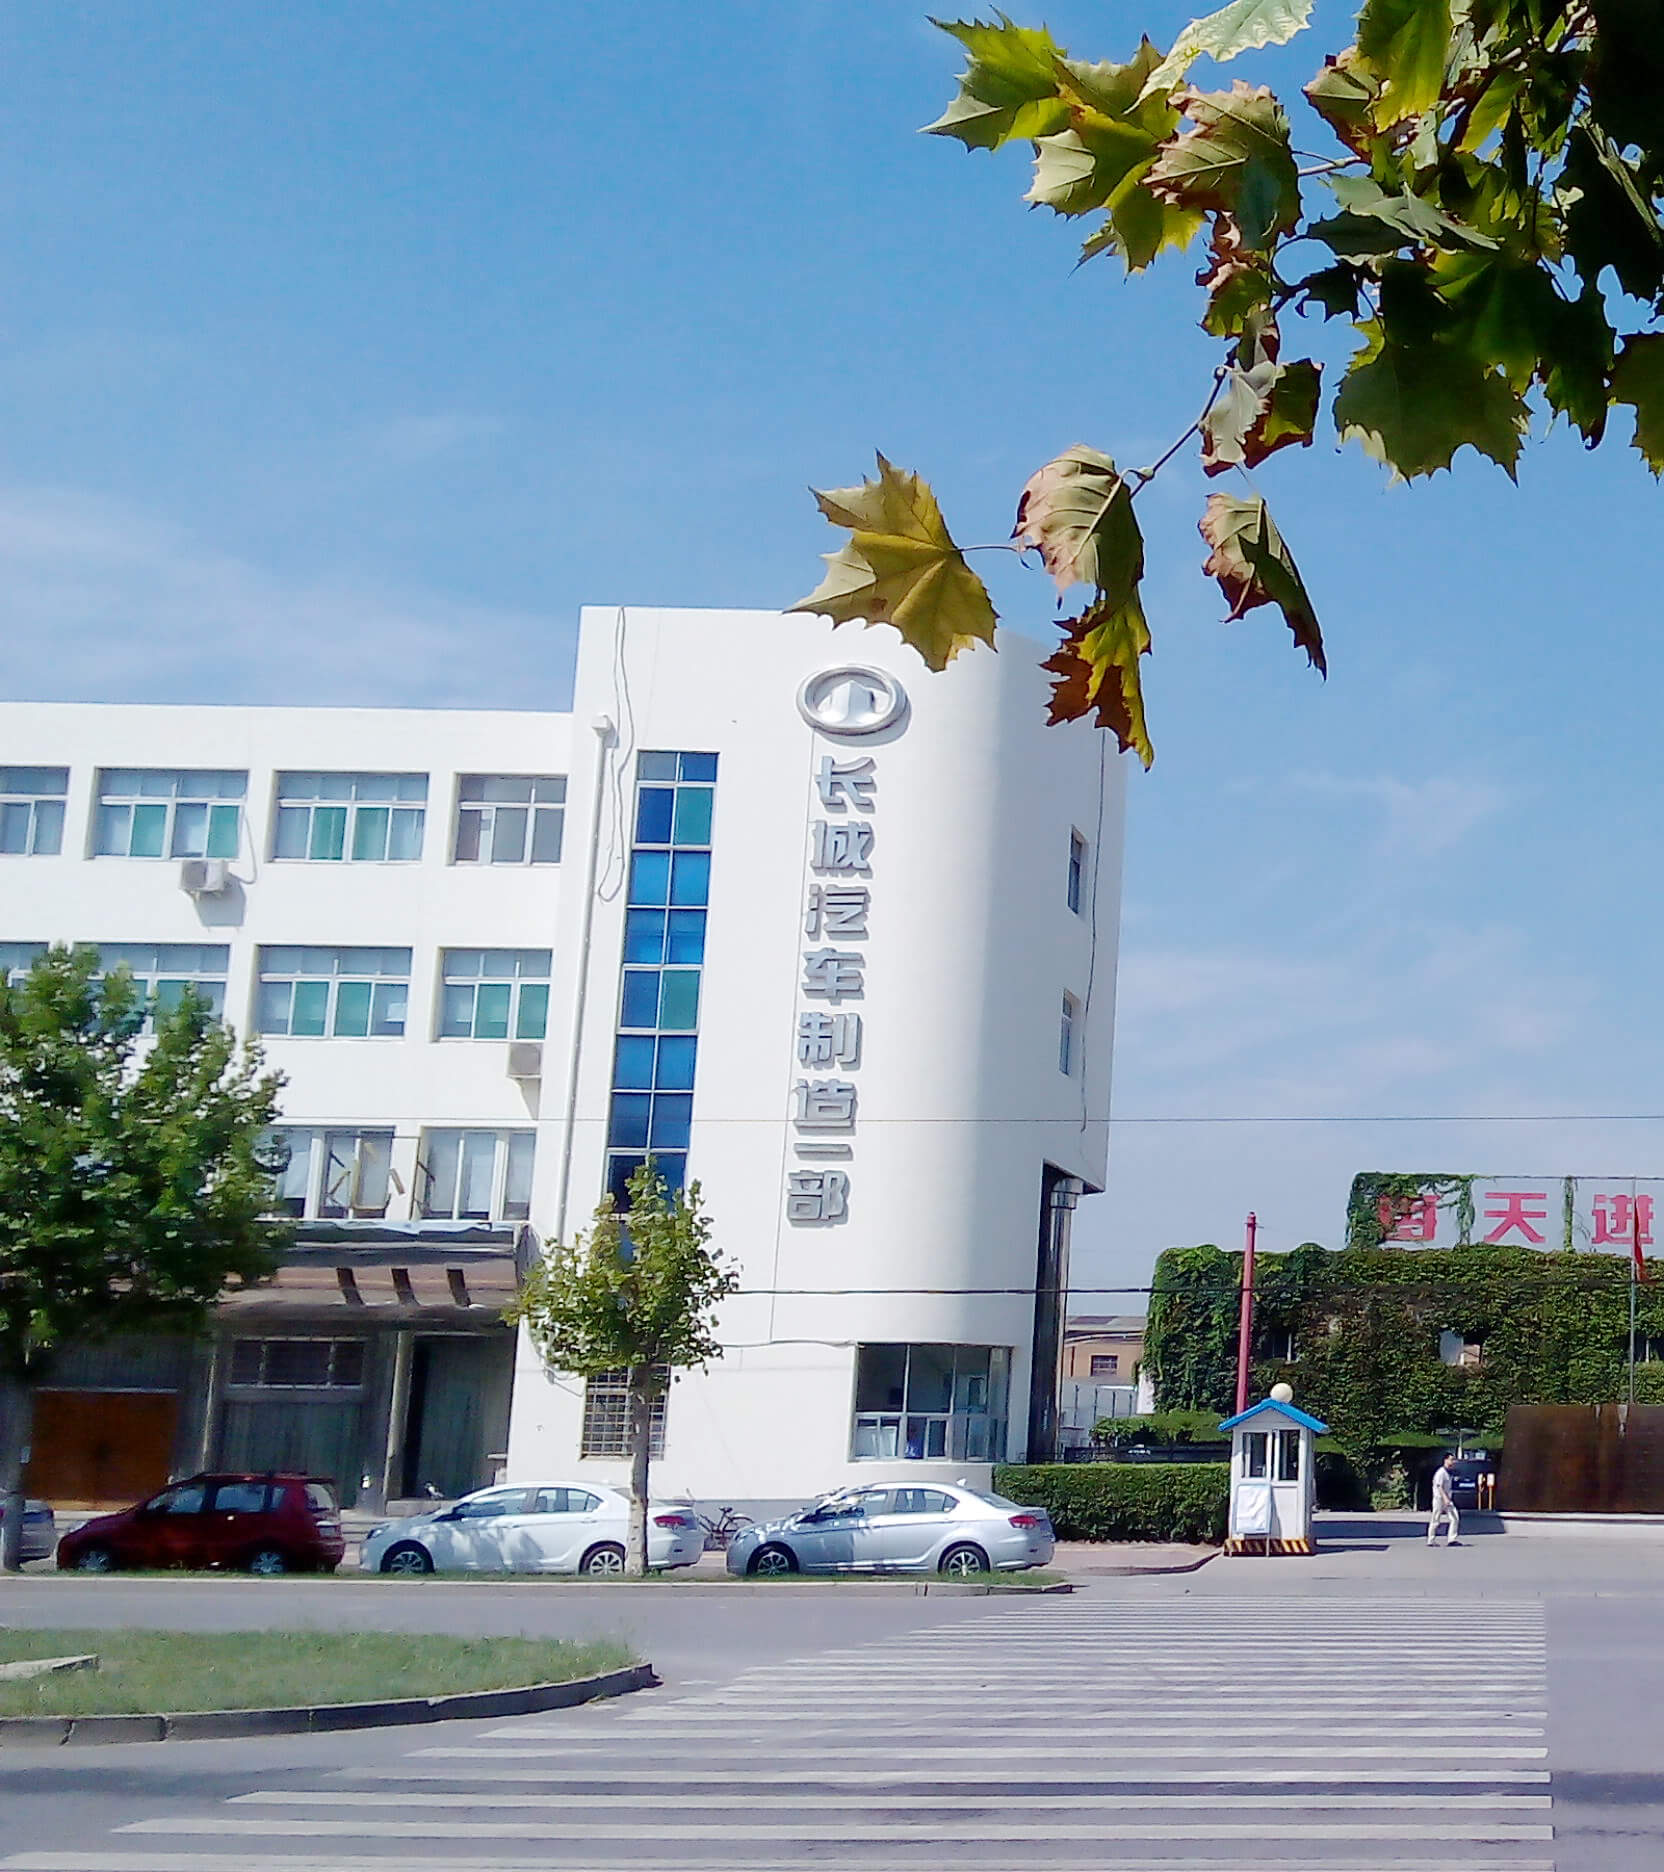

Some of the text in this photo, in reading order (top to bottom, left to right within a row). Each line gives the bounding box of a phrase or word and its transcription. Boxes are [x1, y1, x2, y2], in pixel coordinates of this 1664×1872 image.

[787, 755, 877, 1229] 长城汽车制造一部
